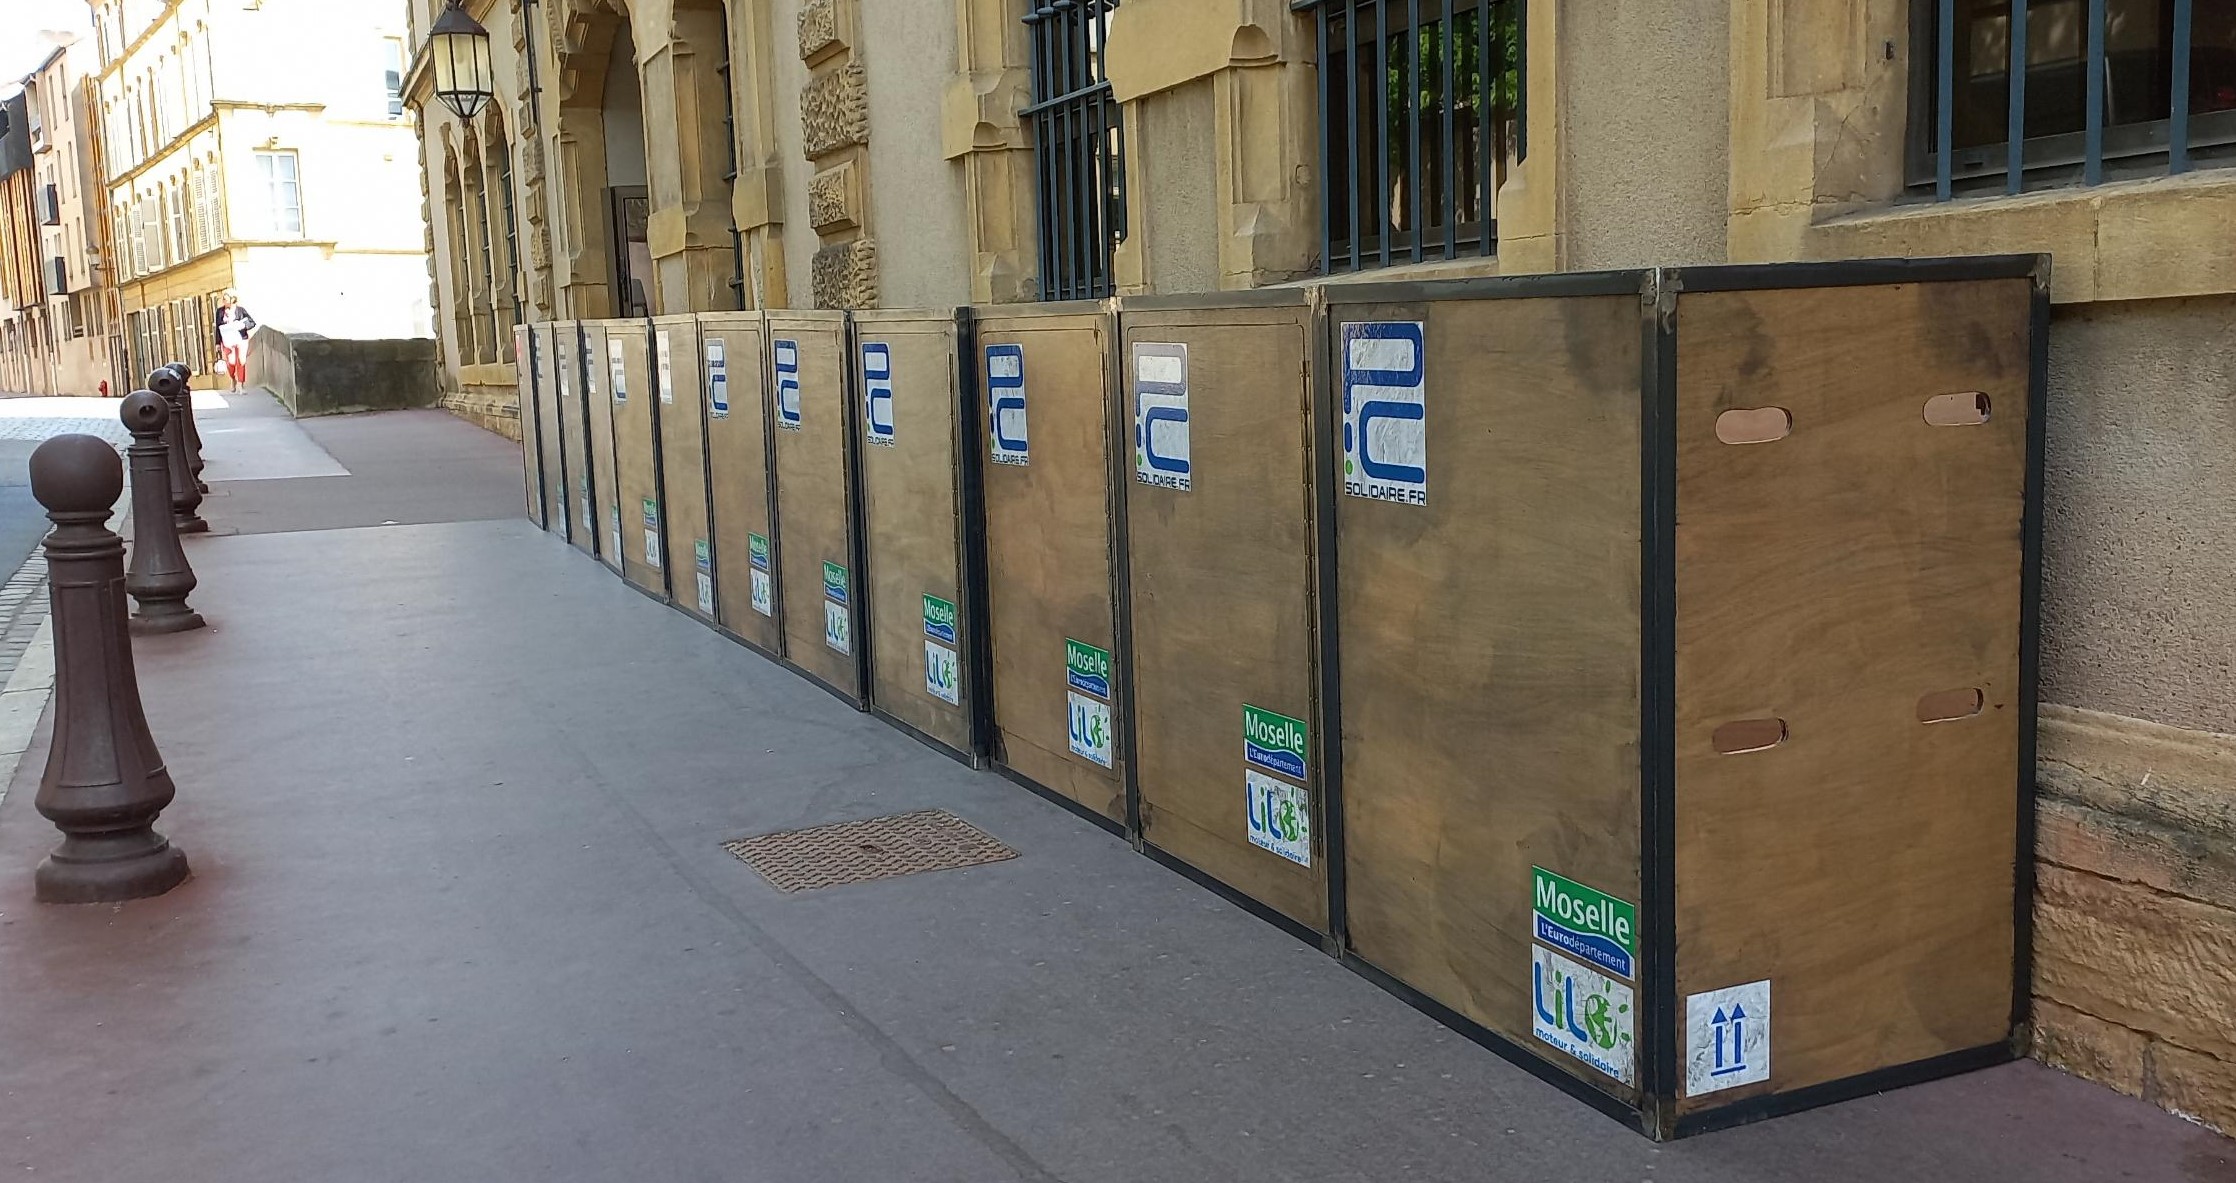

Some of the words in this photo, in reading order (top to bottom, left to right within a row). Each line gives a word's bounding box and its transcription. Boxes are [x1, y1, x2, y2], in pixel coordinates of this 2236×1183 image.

[1345, 482, 1426, 505] SOLIDAIRE.FR
[923, 597, 954, 626] Moselle
[1067, 643, 1108, 677] Moselle
[1245, 711, 1304, 754] Moselle
[1536, 874, 1630, 945] Moselle
[1541, 921, 1626, 971] L'Eurodépartement
[1535, 1028, 1568, 1051] moteur
[1570, 1043, 1577, 1055] &
[1578, 1047, 1619, 1078] solidaire
